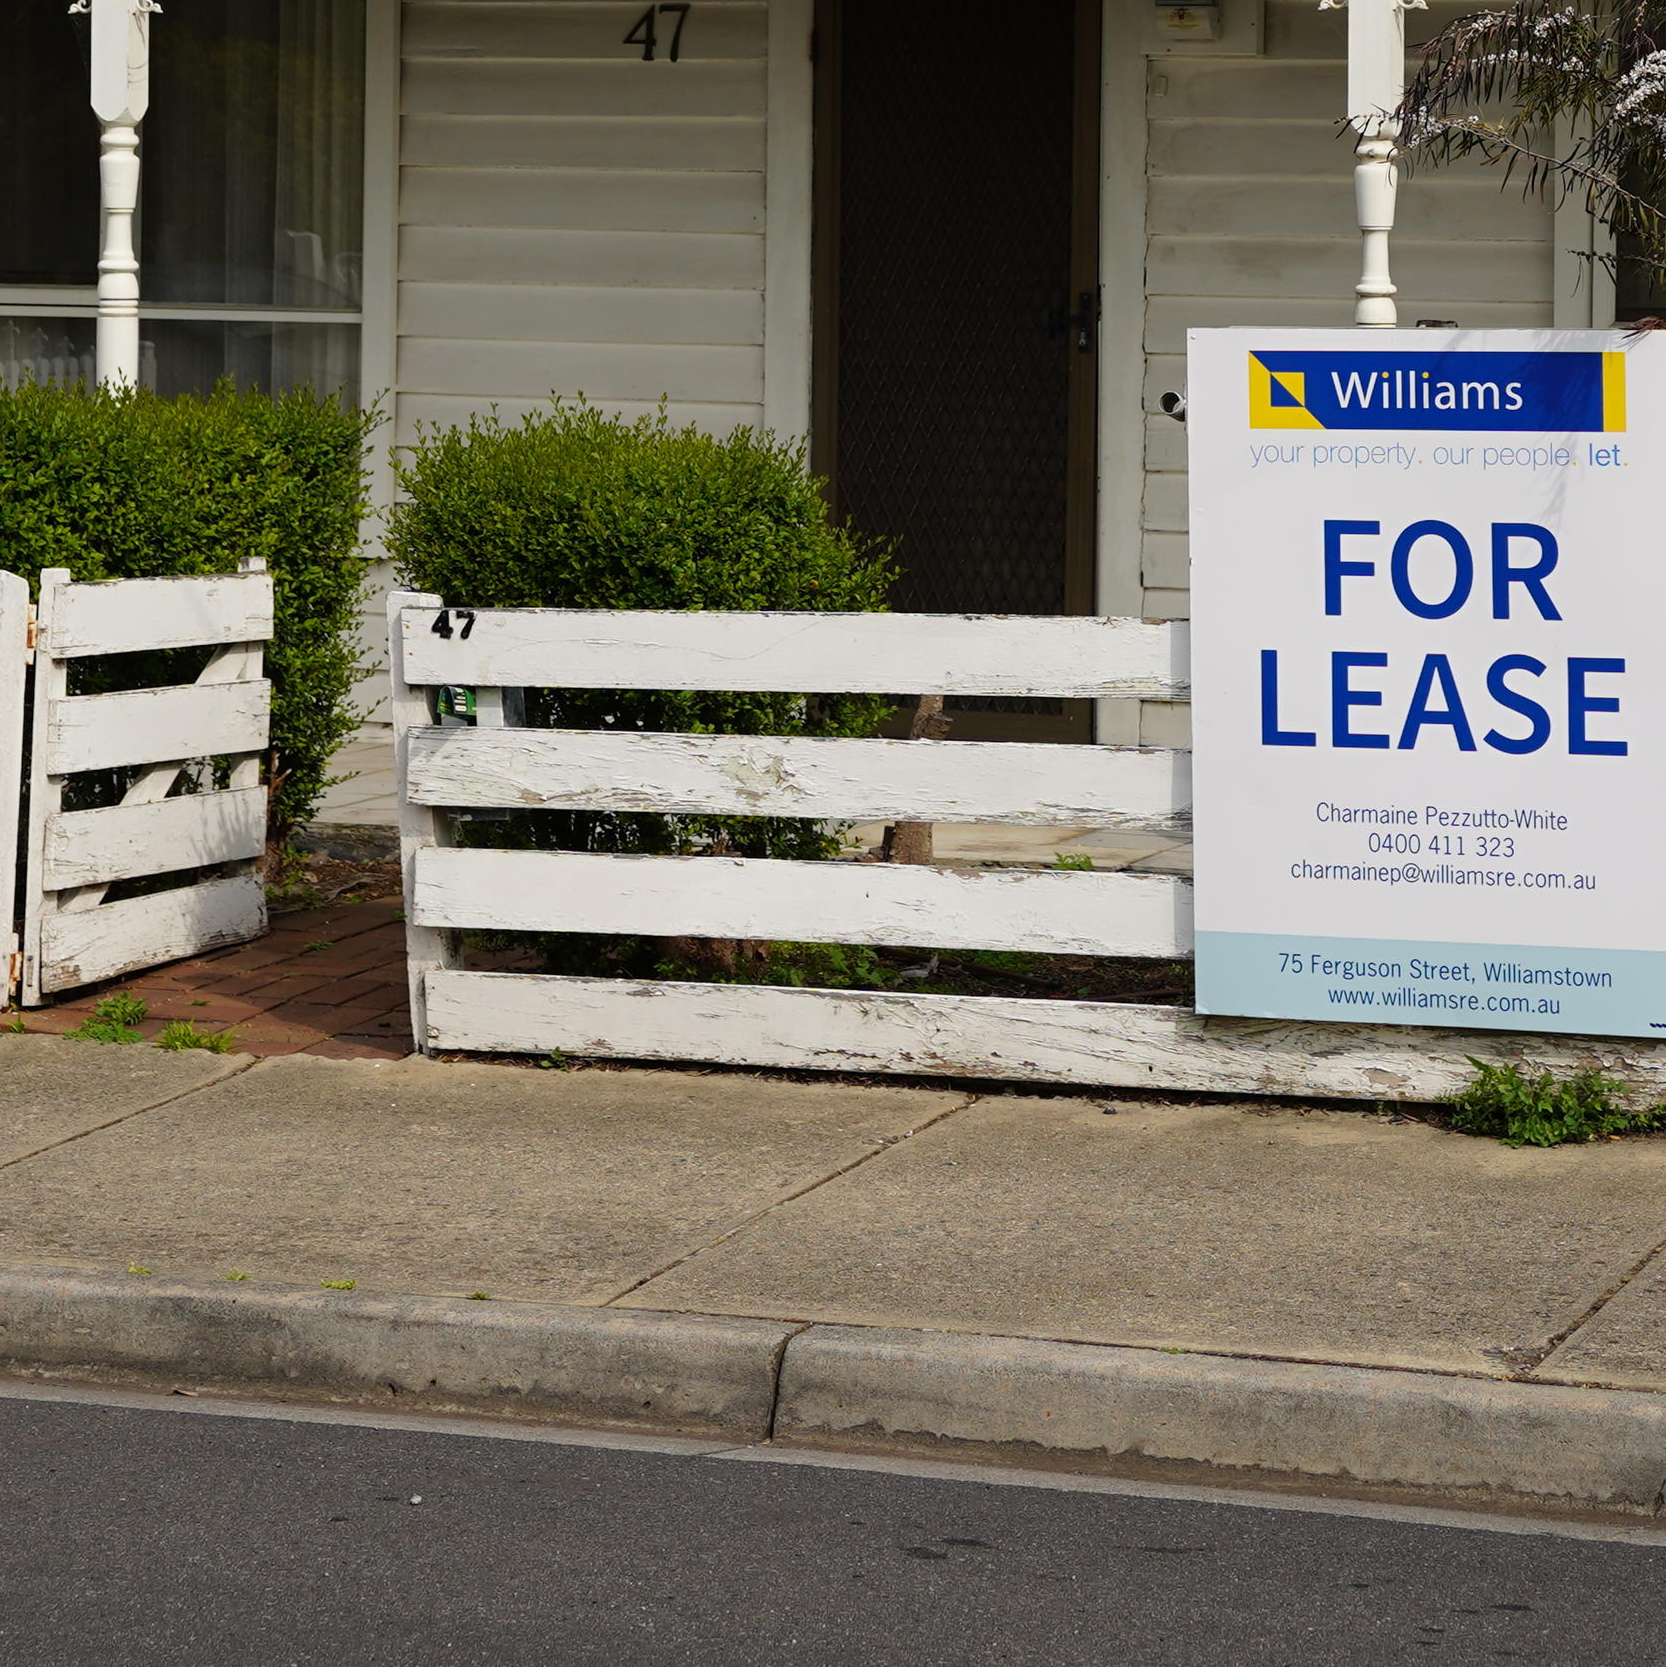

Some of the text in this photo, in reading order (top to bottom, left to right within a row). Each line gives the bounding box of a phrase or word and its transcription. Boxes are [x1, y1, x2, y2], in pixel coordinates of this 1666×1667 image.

[622, 2, 691, 63] 47
[1331, 369, 1524, 411] Williams
[1250, 442, 1629, 470] your property. our people. let.
[1323, 519, 1563, 622] FOR
[431, 609, 478, 640] 47
[1260, 649, 1629, 757] LEASE
[1316, 802, 1569, 831] Charmaine Pezzutto-White
[1368, 832, 1515, 859] 0400 411 323
[1290, 860, 1596, 891] charmainep@williamsre.com.au
[1278, 952, 1612, 988] 75 Ferguson Street, Williamstown
[1328, 987, 1561, 1015] www.williamsre.com.au
